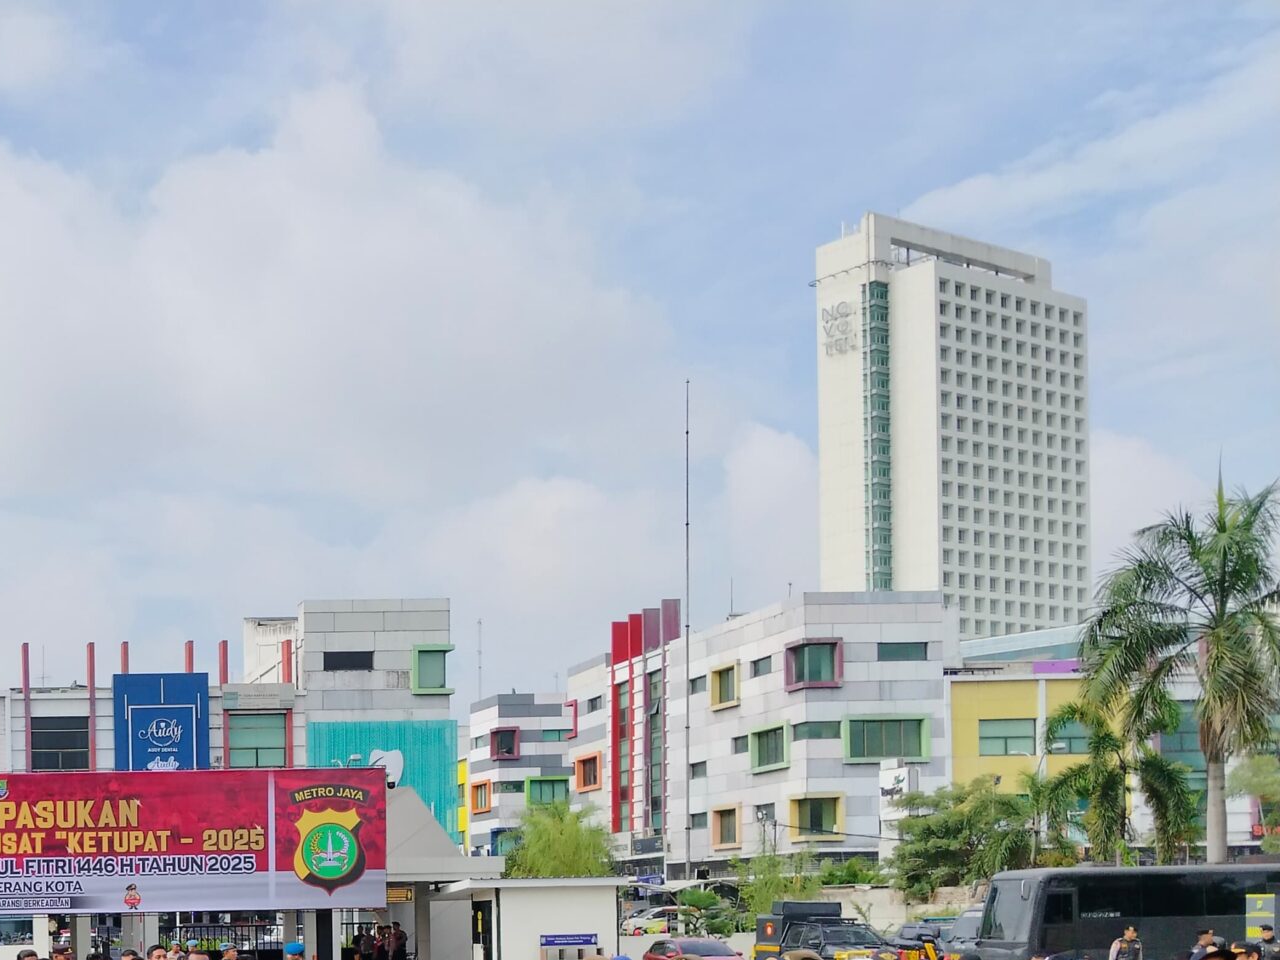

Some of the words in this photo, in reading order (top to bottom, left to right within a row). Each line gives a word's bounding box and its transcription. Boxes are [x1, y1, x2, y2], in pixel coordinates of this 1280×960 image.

[139, 719, 183, 743] Audy
[294, 787, 335, 802] METRO
[337, 787, 363, 801] JAYA
[203, 828, 265, 851] 2025
[26, 858, 72, 875] FITRI
[76, 857, 115, 875] 1446
[121, 857, 133, 873] H
[138, 856, 203, 873] TAHUN
[208, 856, 255, 872] 2025
[47, 880, 83, 892] KOTA
[23, 898, 70, 908] BERKEADILAN
